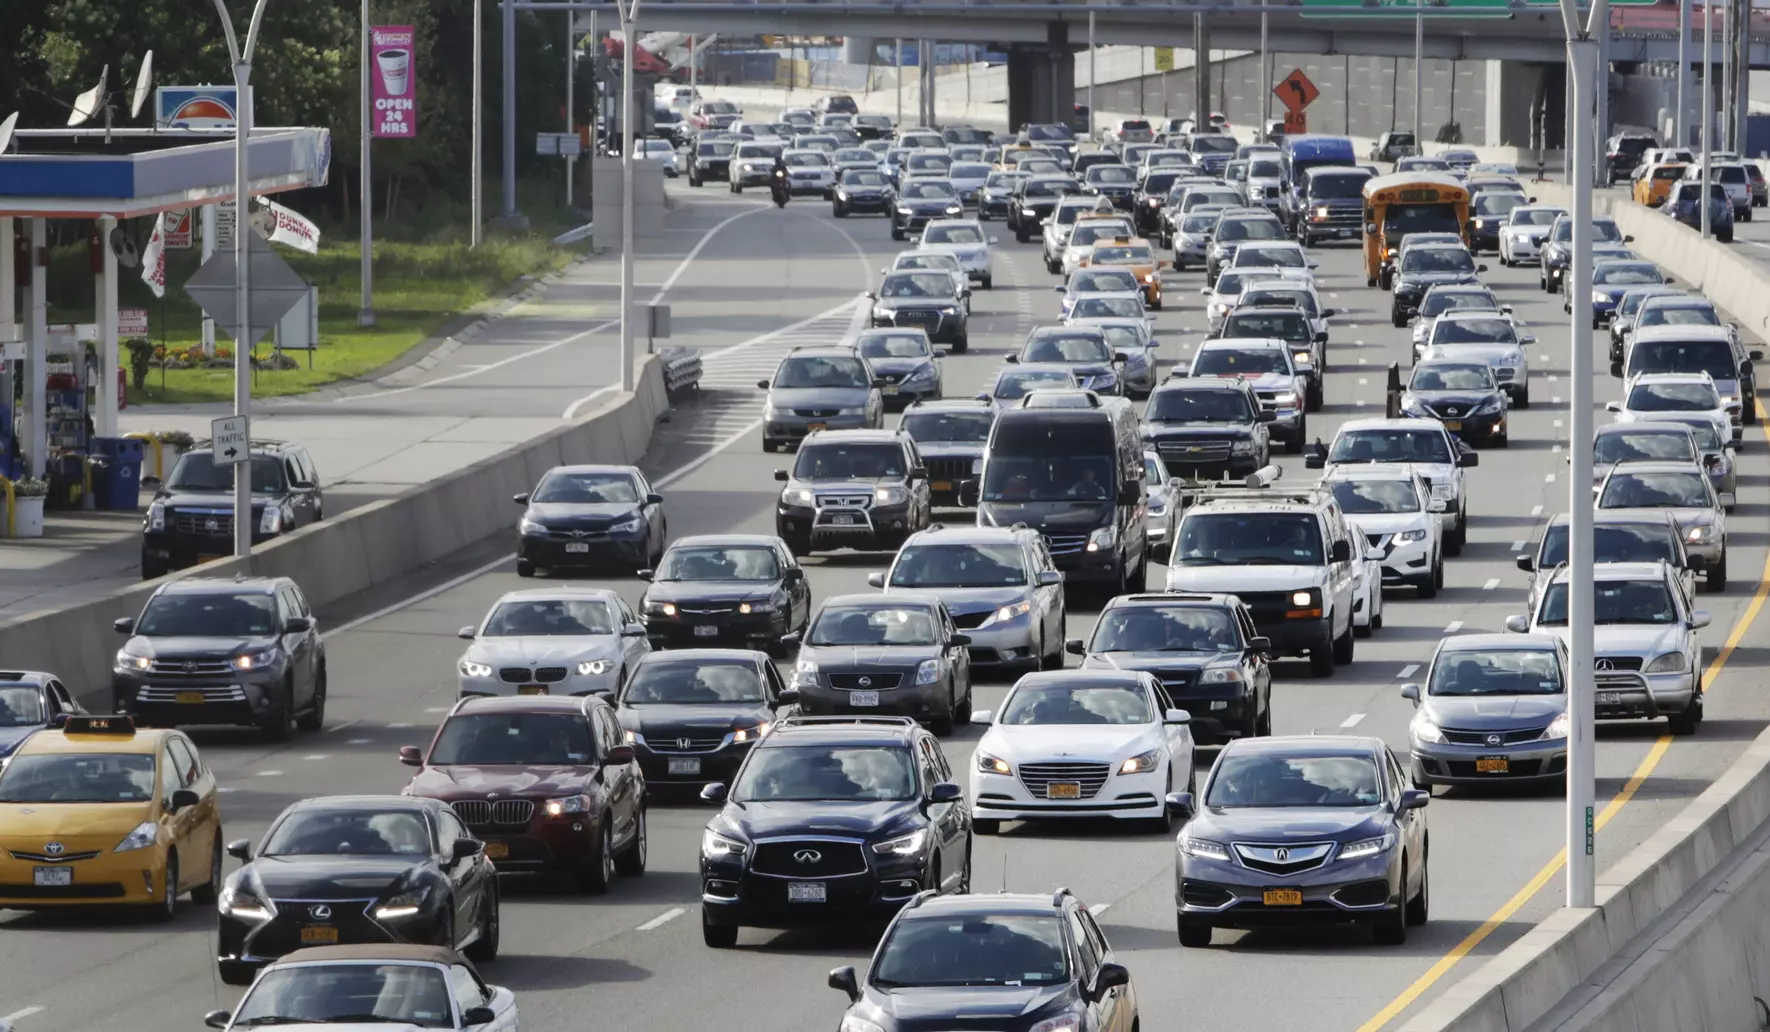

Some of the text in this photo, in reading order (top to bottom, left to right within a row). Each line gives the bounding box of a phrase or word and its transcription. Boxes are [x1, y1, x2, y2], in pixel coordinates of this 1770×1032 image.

[375, 98, 413, 110] OPEN
[385, 110, 403, 122] 24
[1285, 114, 1306, 127] 40
[381, 122, 408, 134] HRS
[224, 421, 236, 431] ALL
[217, 432, 245, 445] TRAFFIC
